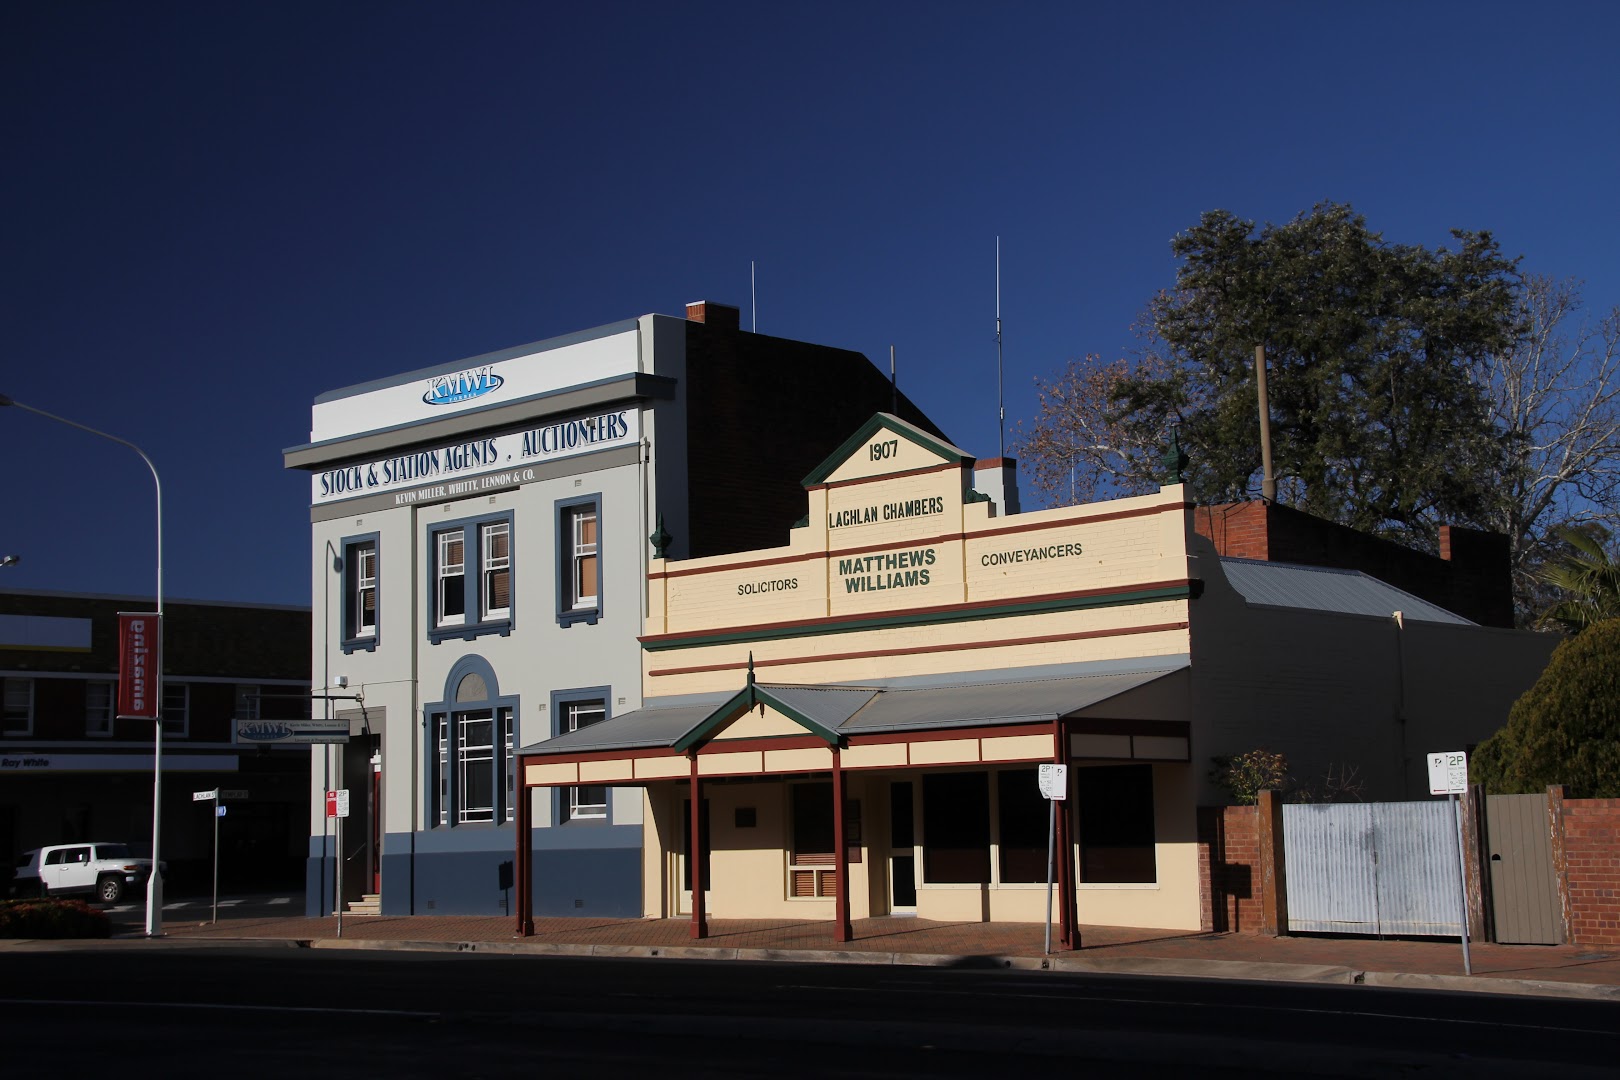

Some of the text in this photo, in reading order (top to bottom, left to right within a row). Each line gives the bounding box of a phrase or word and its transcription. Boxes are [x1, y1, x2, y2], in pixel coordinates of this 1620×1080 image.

[427, 365, 498, 400] KMWL
[321, 411, 628, 496] STOCK & STATION AGENTS AUCTIONEERS
[869, 439, 898, 462] 1907
[395, 469, 535, 505] KEVIN MILLER, WHITTY, LENNON & CO.
[828, 496, 944, 529] LACHLAN CHAMBERS
[839, 548, 936, 576] MATTHEWS
[981, 542, 1083, 567] CONVEYANCERS
[737, 578, 798, 596] SOLICITORS
[845, 569, 930, 594] WILLIAMS
[240, 722, 290, 734] KMWL
[1, 758, 49, 768] Ray White
[1448, 756, 1464, 766] 2P
